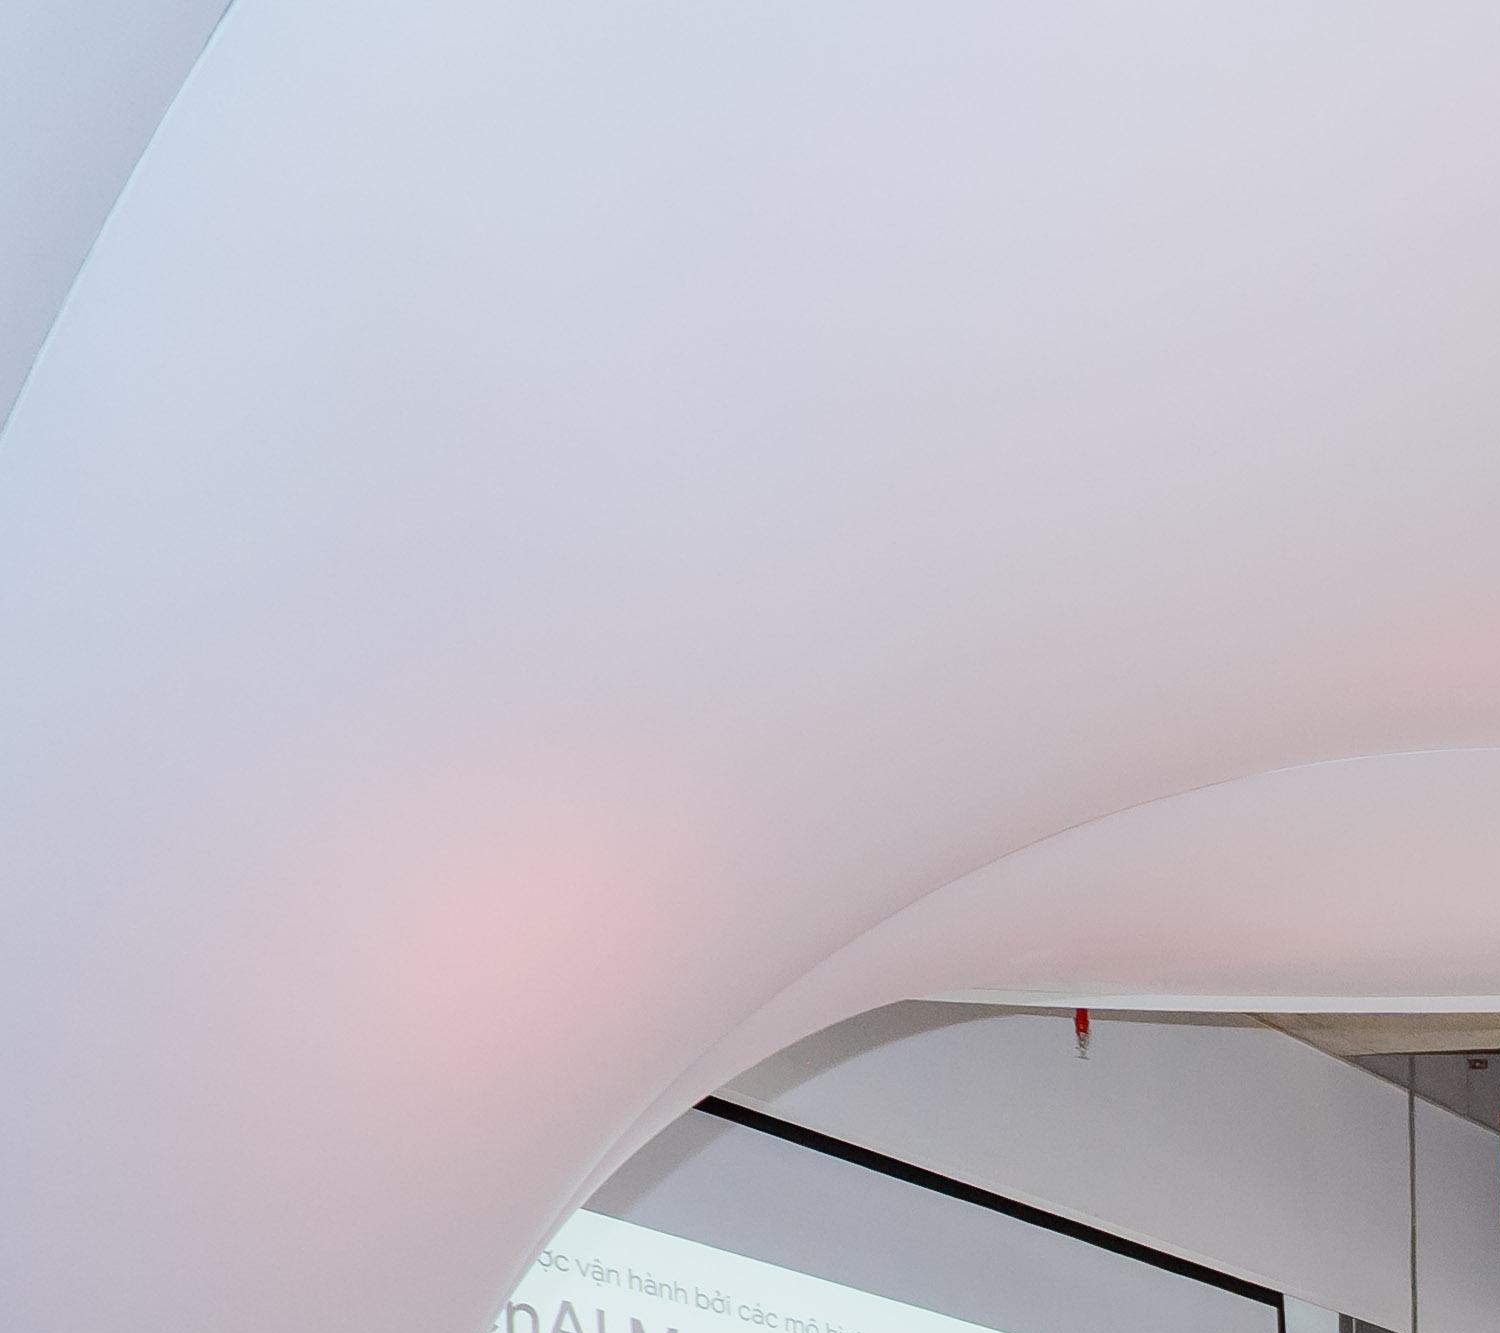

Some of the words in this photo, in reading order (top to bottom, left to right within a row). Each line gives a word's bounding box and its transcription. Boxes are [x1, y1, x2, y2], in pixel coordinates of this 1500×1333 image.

[537, 1250, 572, 1278] ợc
[577, 1258, 622, 1288] vận
[628, 1267, 688, 1306] hành
[738, 1301, 778, 1330] các
